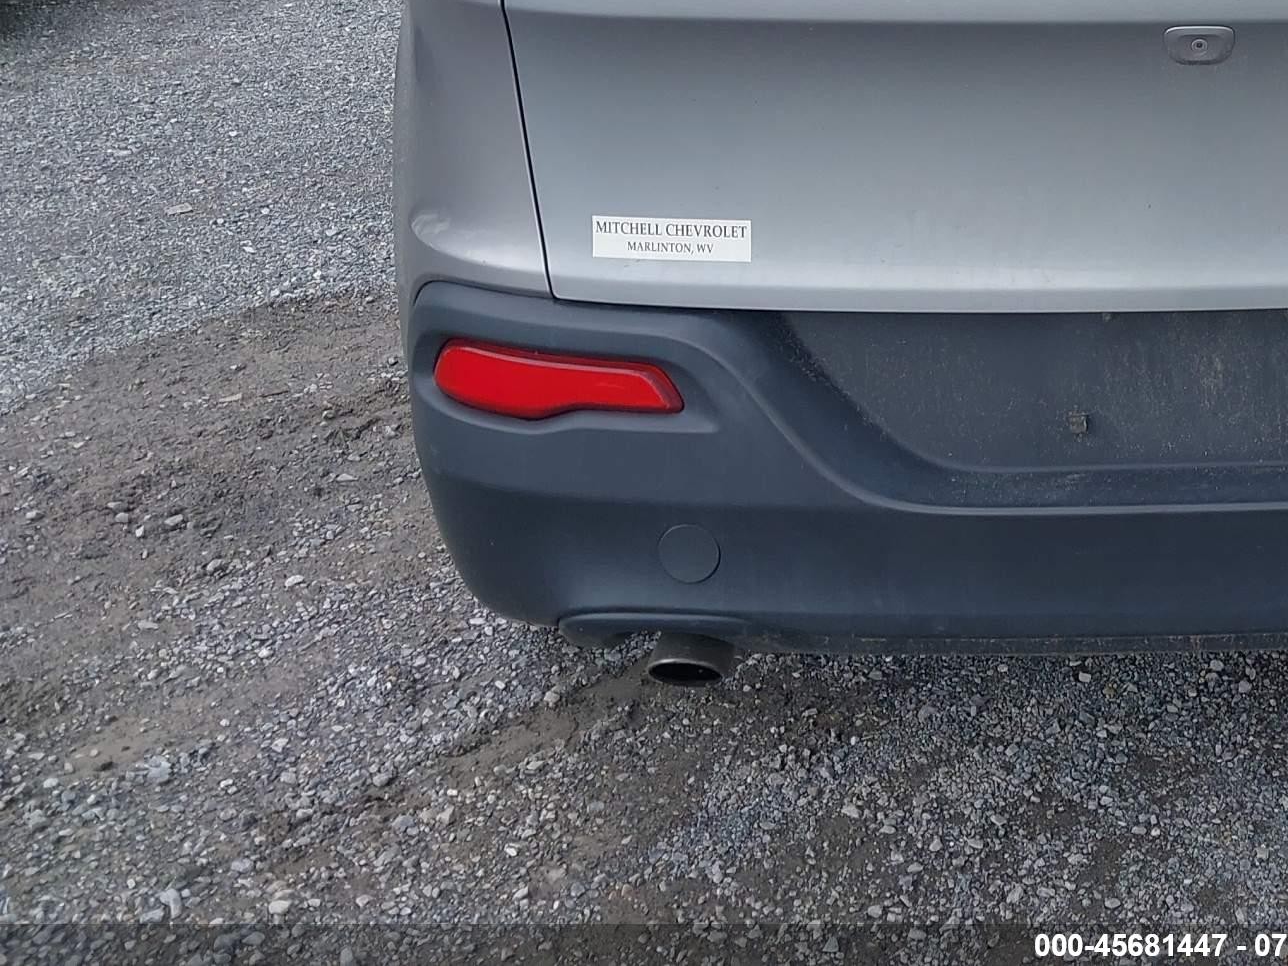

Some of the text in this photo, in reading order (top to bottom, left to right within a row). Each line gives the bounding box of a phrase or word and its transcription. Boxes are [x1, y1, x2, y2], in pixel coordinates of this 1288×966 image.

[595, 220, 748, 239] MITCHELL CHEVROLET
[627, 241, 714, 255] MARLINTON, WV
